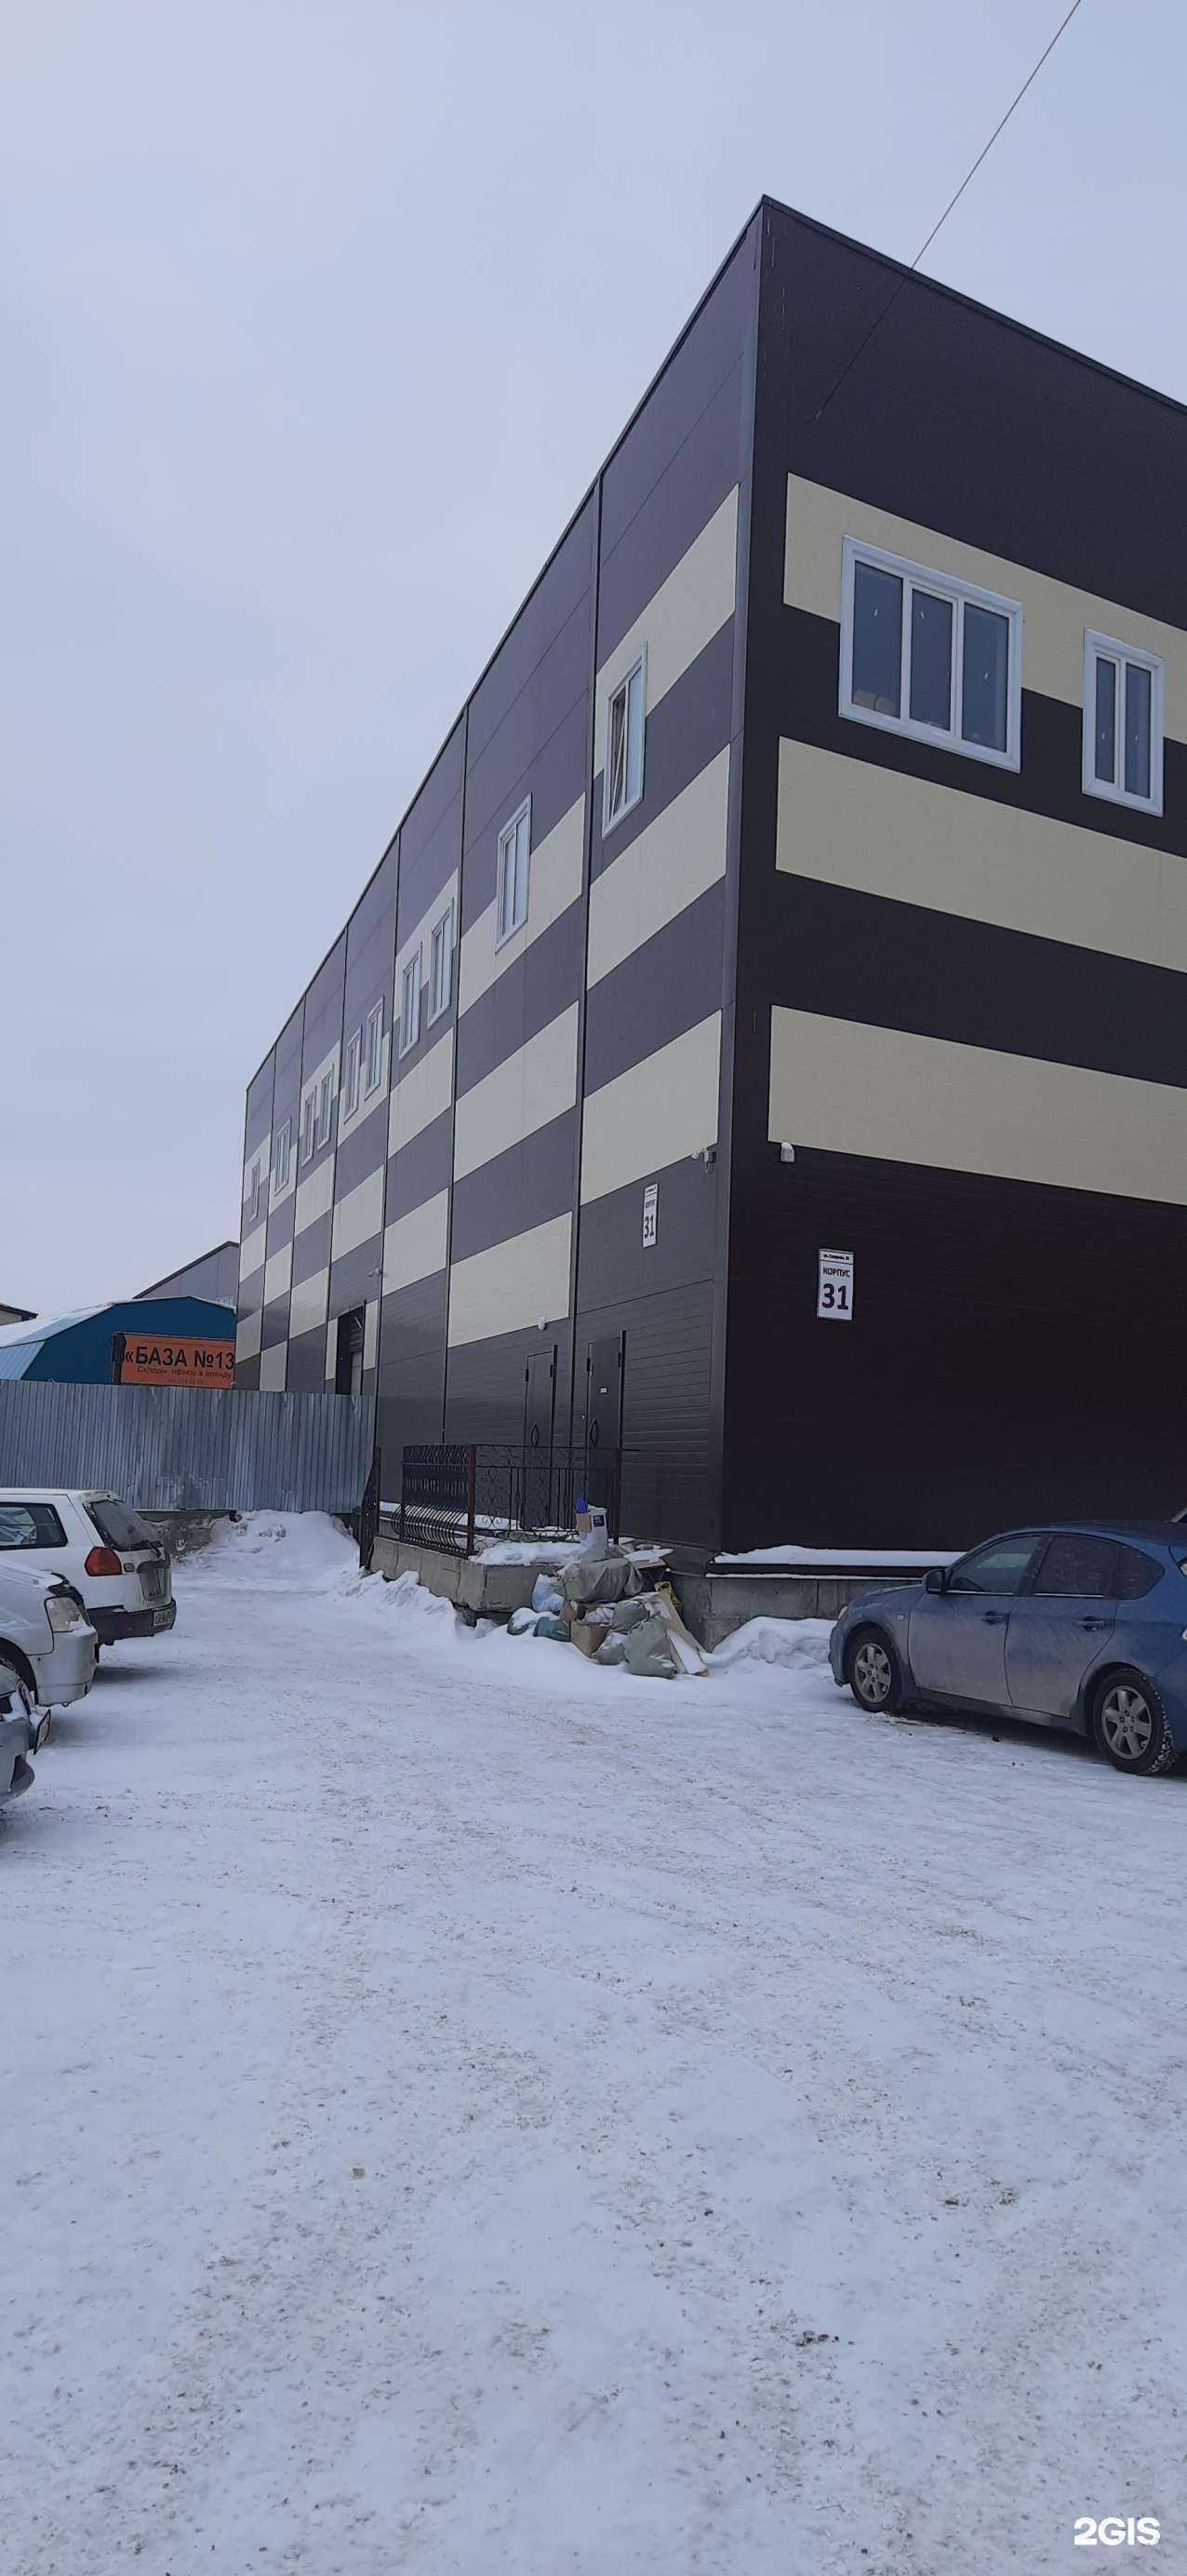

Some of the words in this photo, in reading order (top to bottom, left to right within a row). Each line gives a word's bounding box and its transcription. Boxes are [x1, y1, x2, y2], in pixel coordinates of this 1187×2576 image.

[645, 1214, 655, 1239] 31
[823, 1267, 850, 1278] КОРПУС
[821, 1283, 848, 1310] 31
